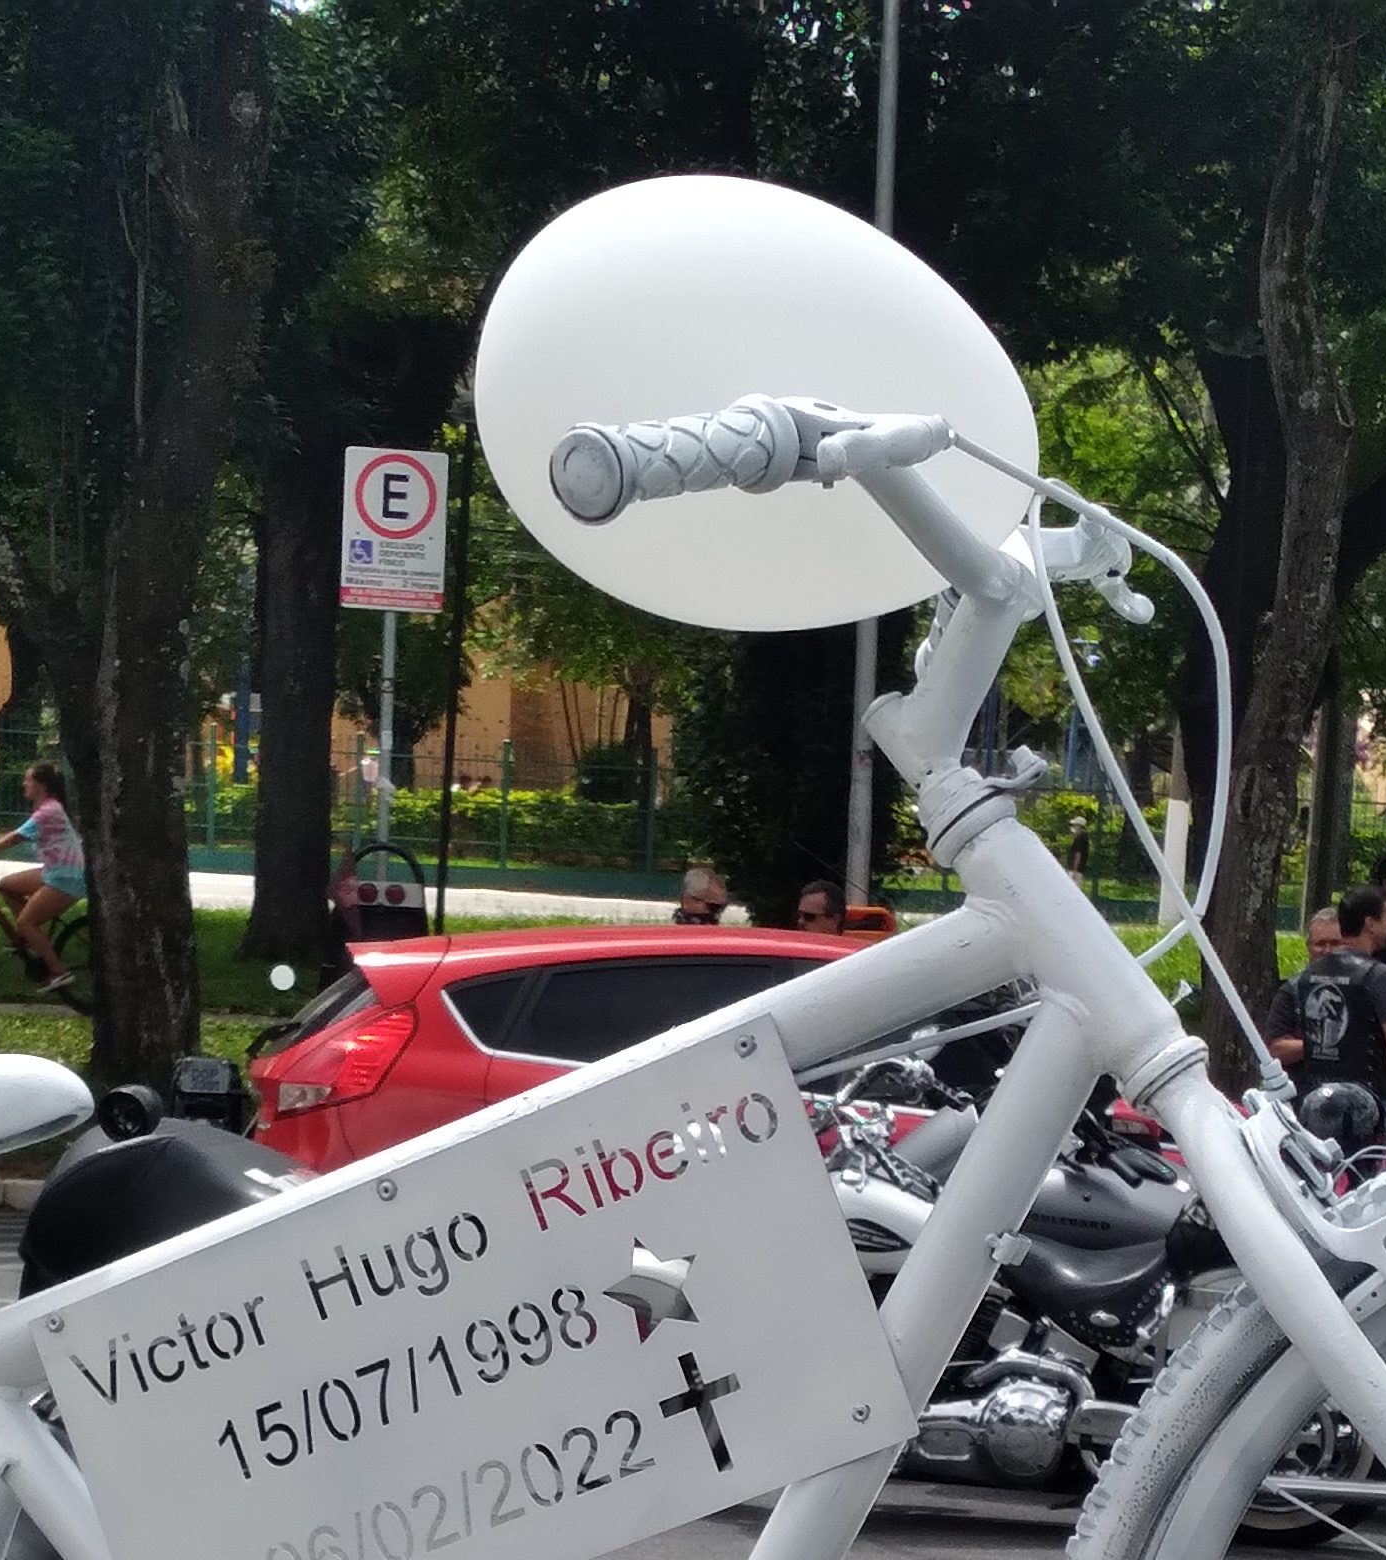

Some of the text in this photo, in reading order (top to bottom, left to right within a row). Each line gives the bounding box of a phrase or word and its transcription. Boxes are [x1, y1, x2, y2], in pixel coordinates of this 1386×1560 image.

[382, 473, 410, 519] E
[69, 1092, 778, 1405] Victor Hugo Ribeiro
[218, 1285, 597, 1480] 15/07/1998
